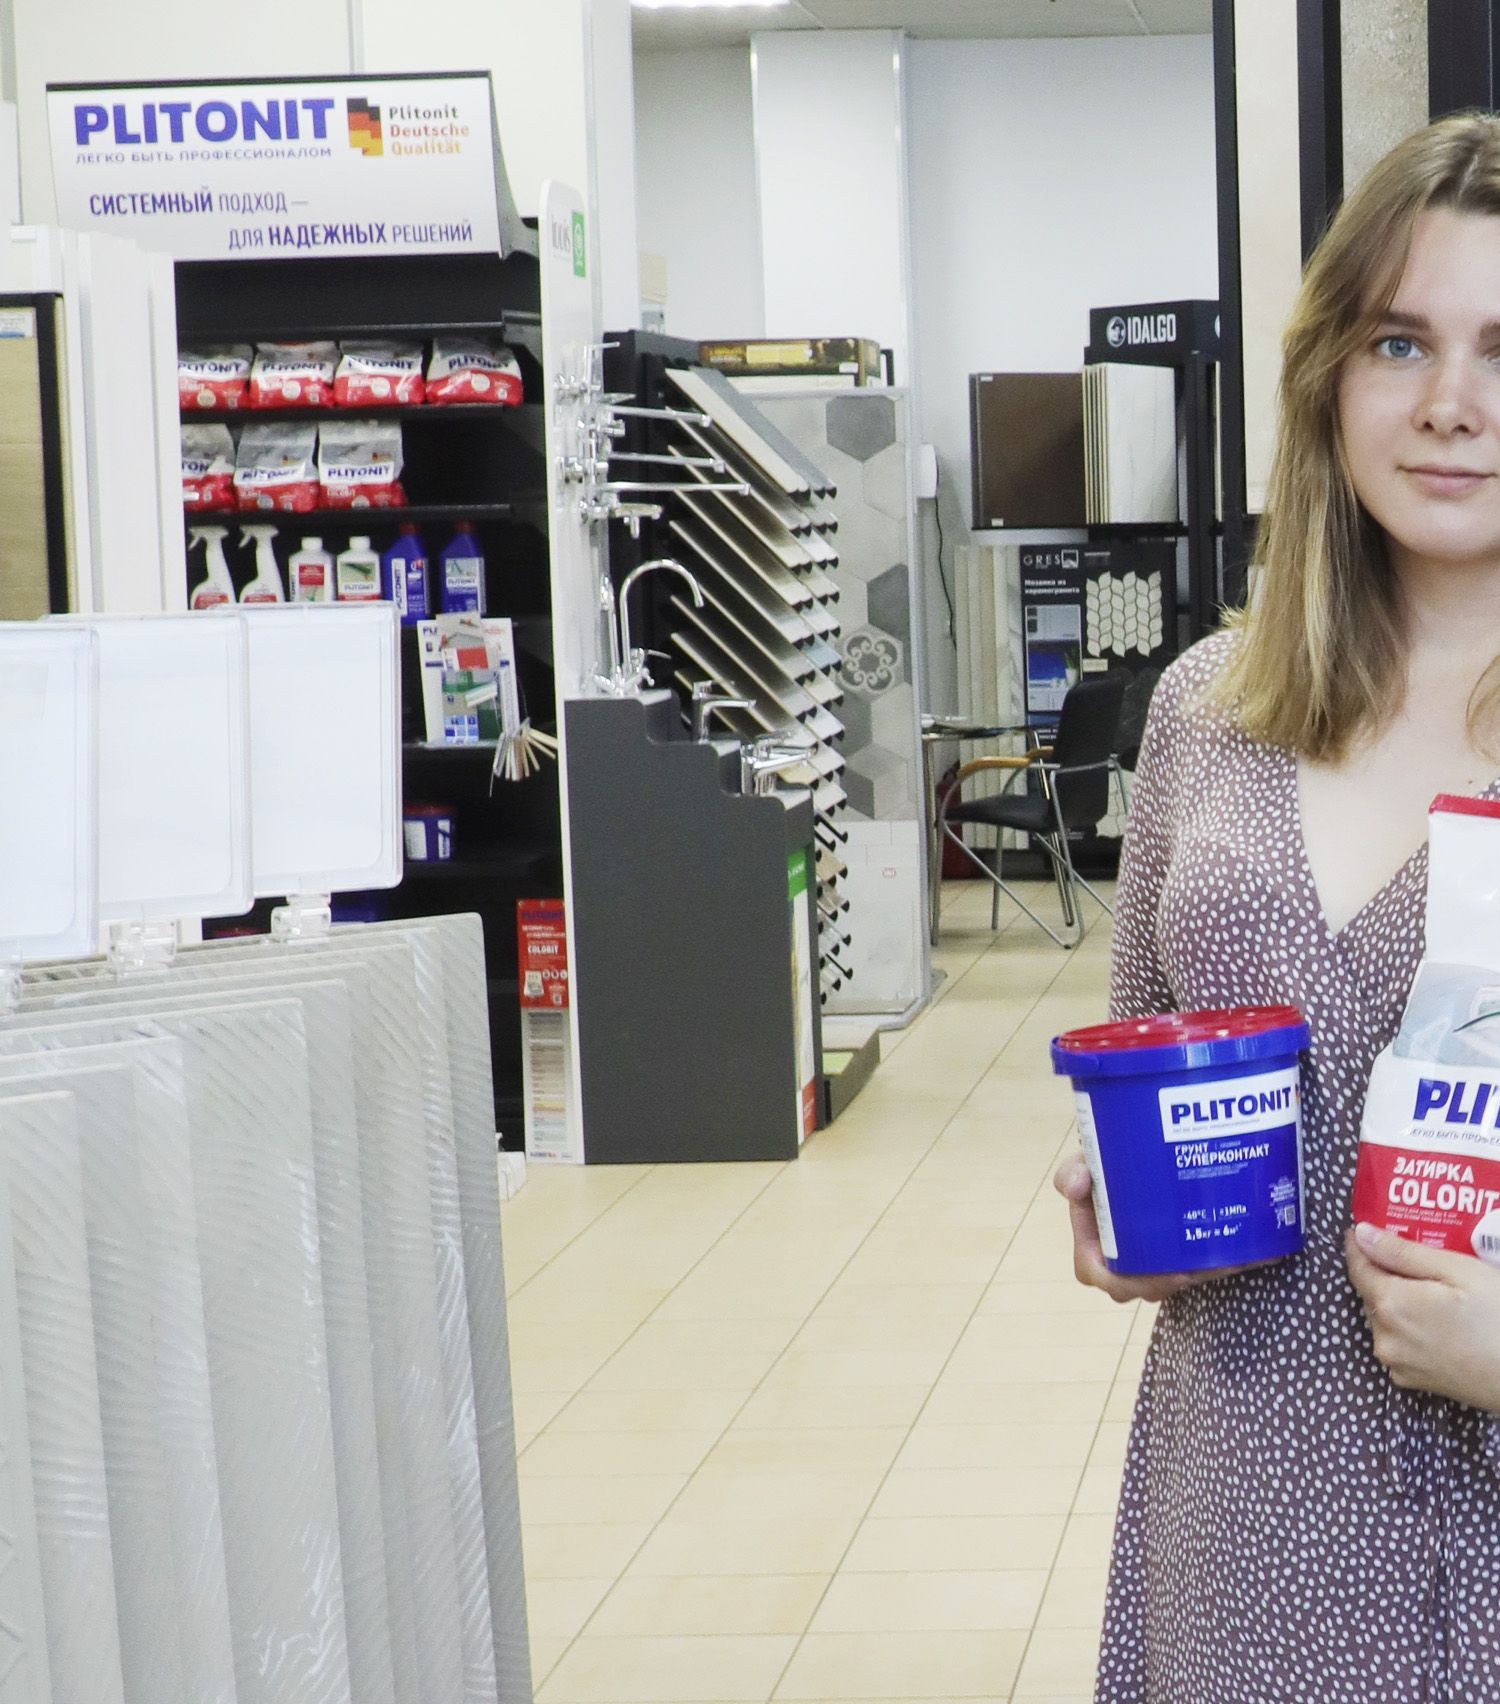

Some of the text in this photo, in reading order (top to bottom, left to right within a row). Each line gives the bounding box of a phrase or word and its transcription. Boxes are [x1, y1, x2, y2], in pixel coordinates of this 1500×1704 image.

[74, 98, 334, 145] PLITONIT
[389, 104, 459, 119] Plitonit
[390, 123, 470, 137] Deutsche
[76, 148, 332, 165] ЛЕГКО БЫТЬ ПРОФЕССИОНАЛОМ
[391, 141, 462, 156] Qualität
[89, 186, 213, 215] СИСТЕМНЫЙ
[218, 191, 288, 214] ПОДХОД
[228, 219, 474, 250] ДЛЯ НАДЕЖНЫХ РЕШЕНИЙ
[1127, 313, 1177, 344] IDALGO
[327, 467, 391, 479] PLITONIT
[1170, 1086, 1292, 1125] PLITONIT
[1174, 1142, 1209, 1157] ГРУНТ
[1175, 1143, 1270, 1169] СУПЕРКОНТАКТ
[1392, 1156, 1475, 1184] ЗАТИРКА
[1388, 1177, 1500, 1215] COLORIT
